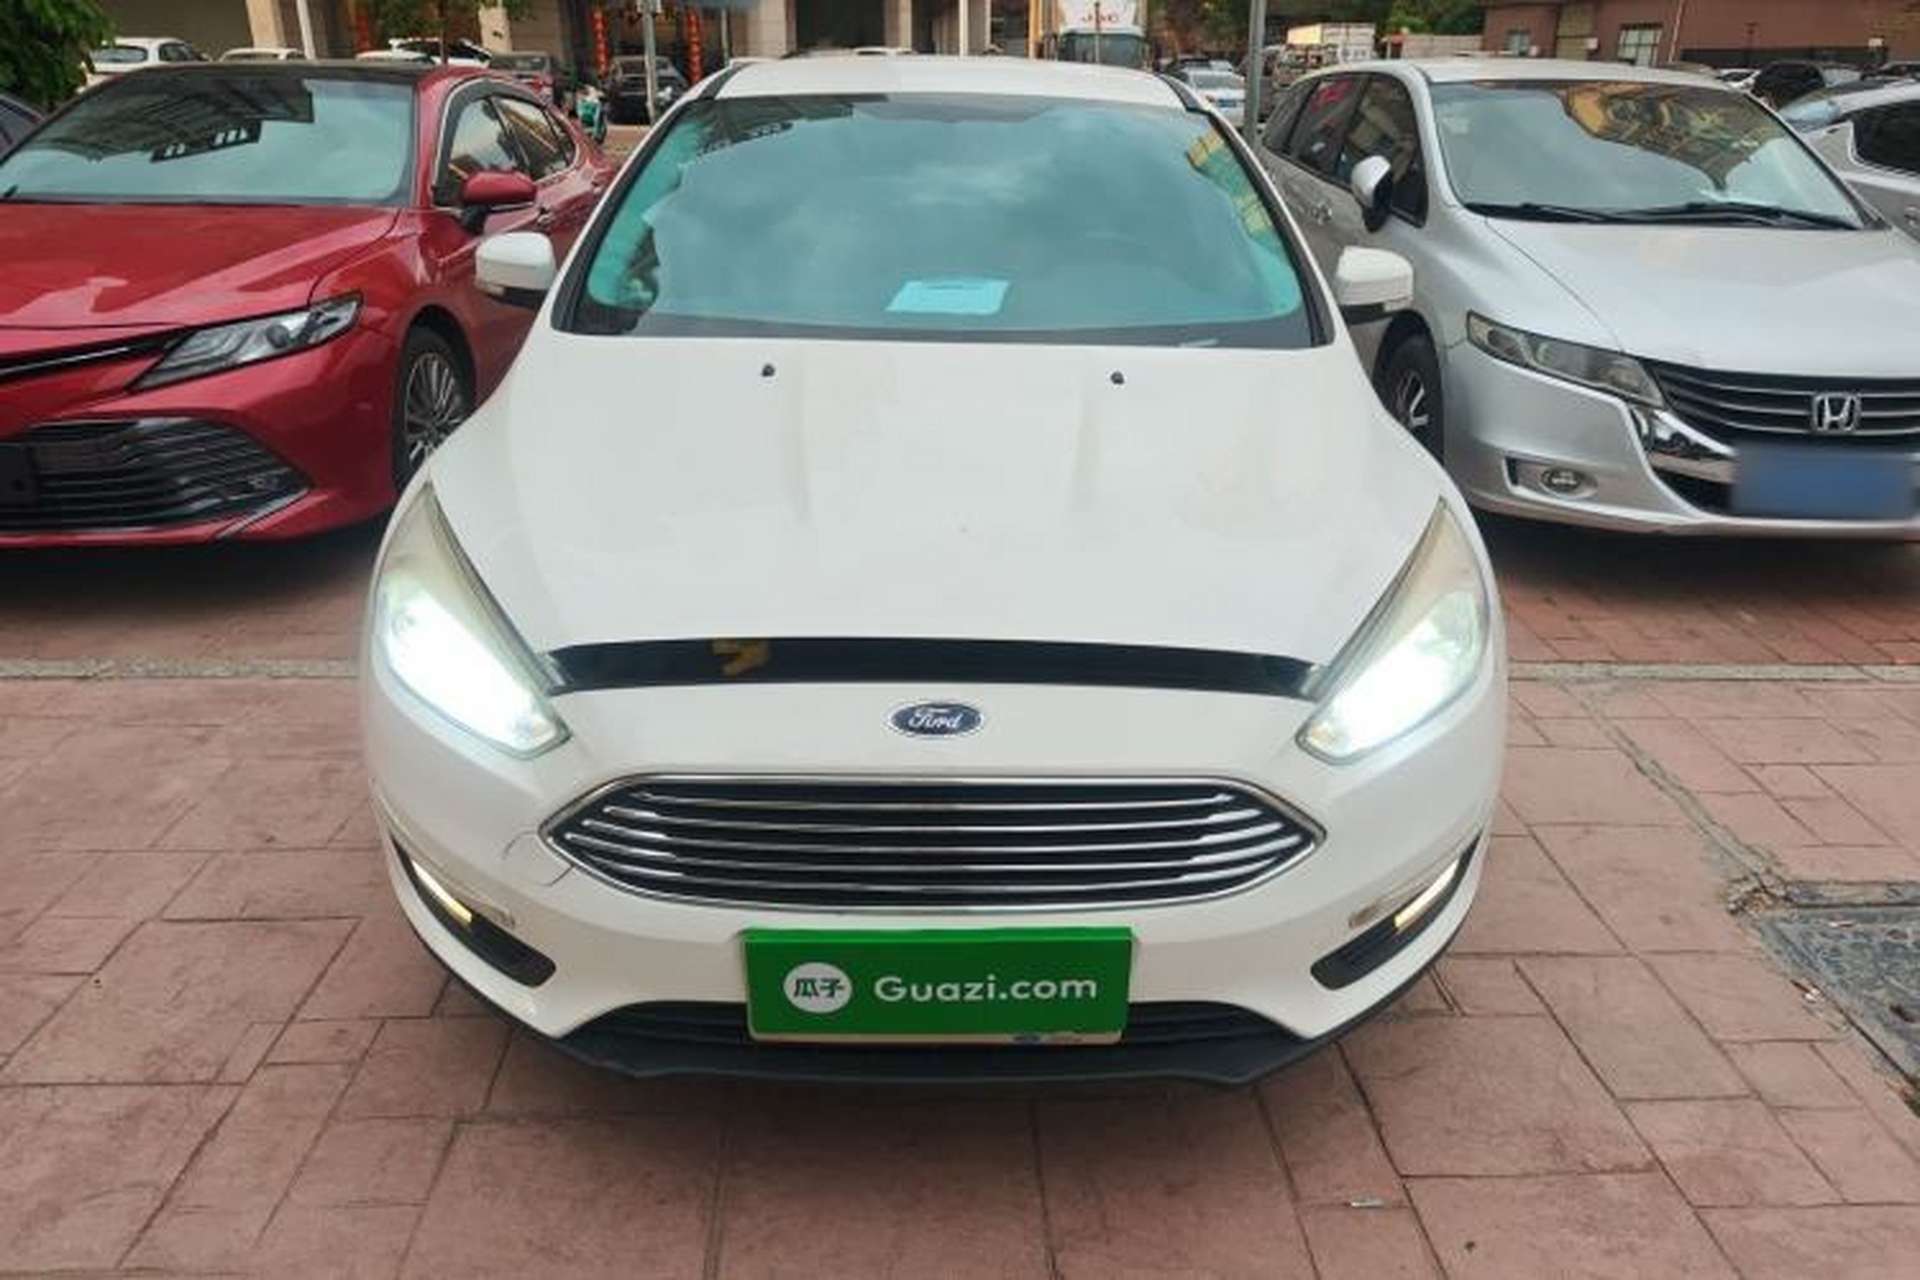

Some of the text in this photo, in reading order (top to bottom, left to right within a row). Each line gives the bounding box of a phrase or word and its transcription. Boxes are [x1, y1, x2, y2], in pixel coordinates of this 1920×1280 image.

[907, 707, 963, 729] Ford
[793, 976, 845, 999] 瓜子
[874, 974, 1097, 1002] Guazi.com
